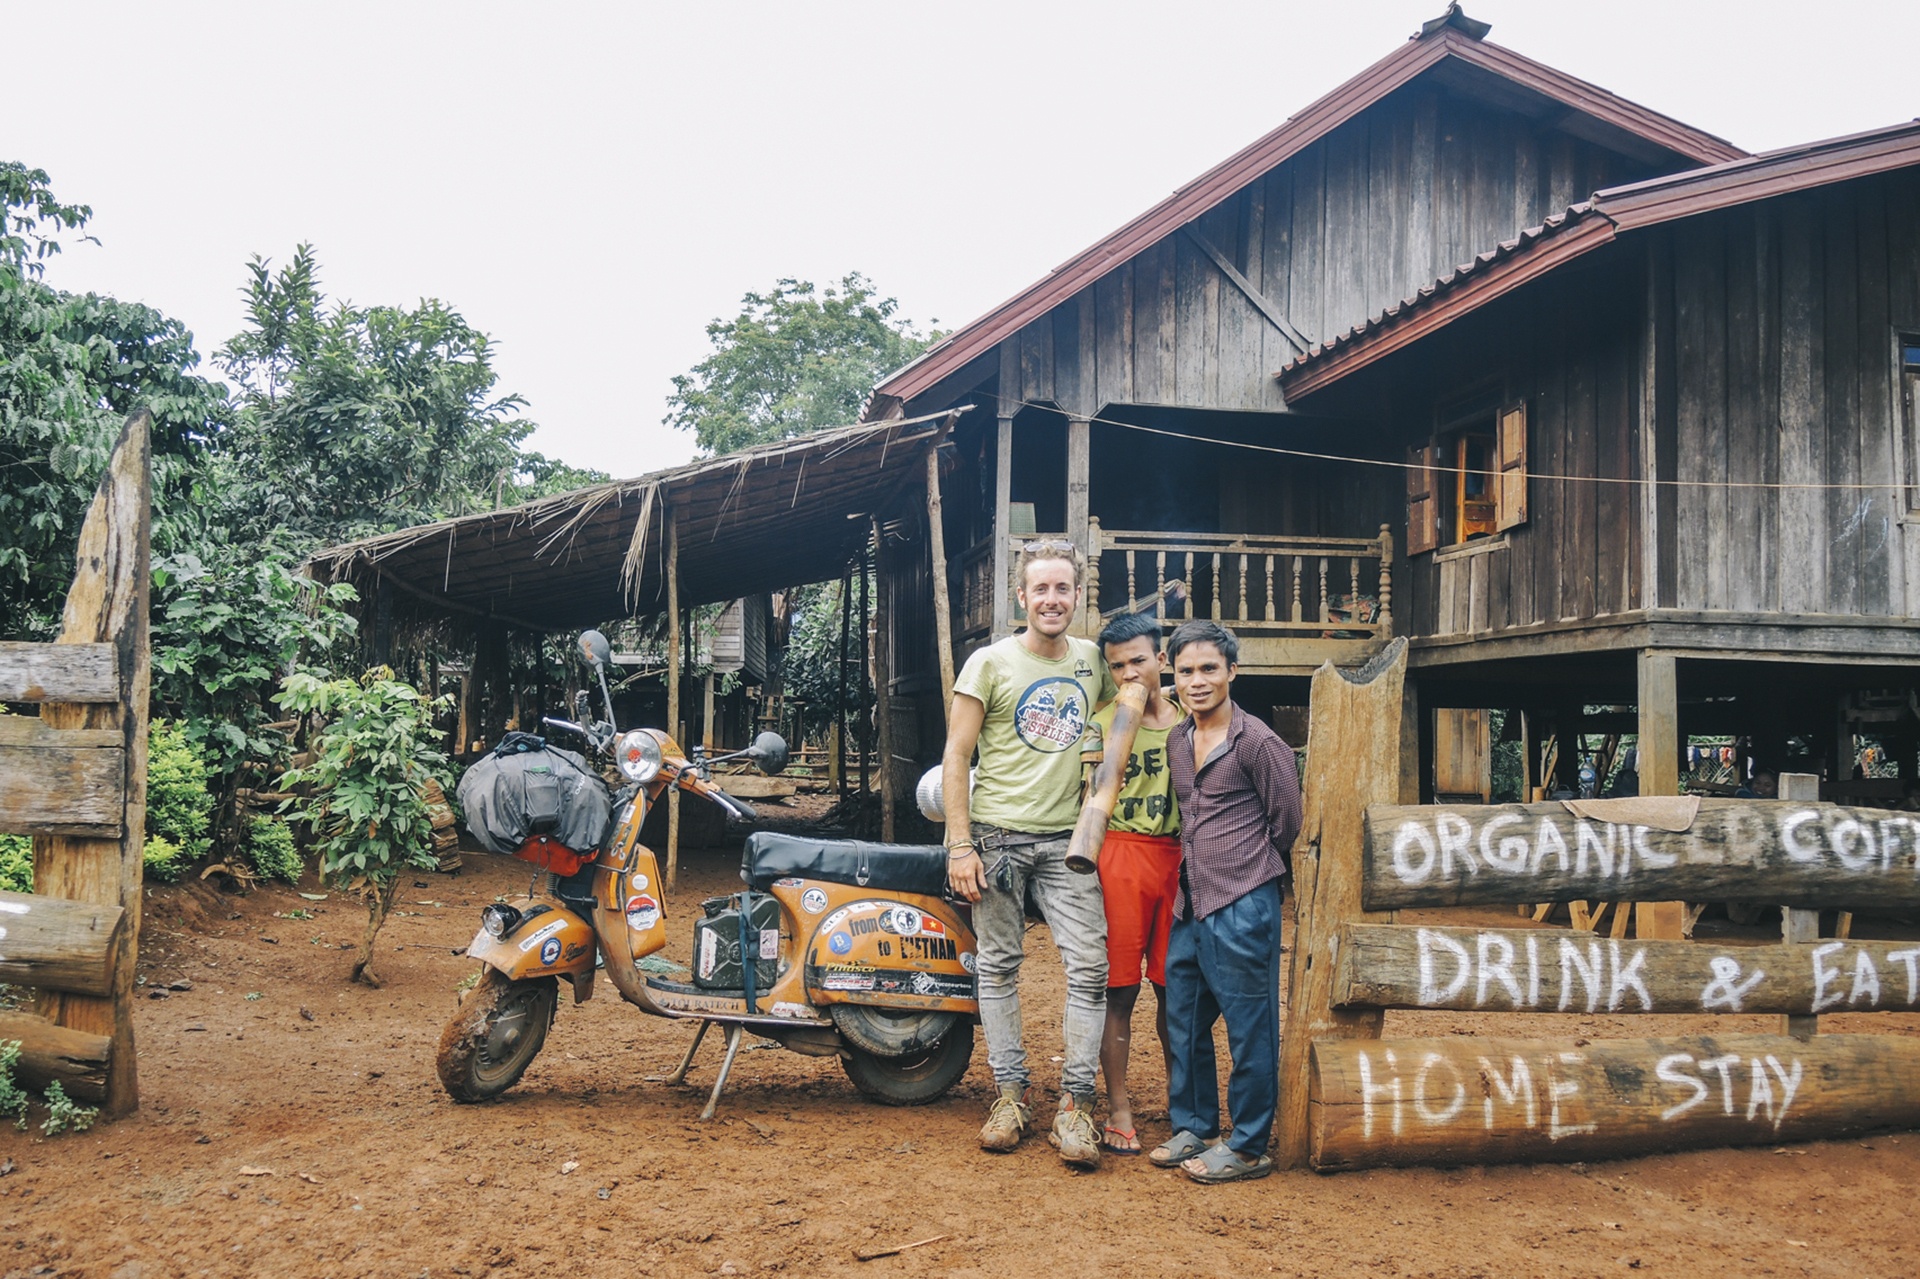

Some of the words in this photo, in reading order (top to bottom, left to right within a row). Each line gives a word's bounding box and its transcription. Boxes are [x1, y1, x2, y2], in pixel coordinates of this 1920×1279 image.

[1393, 811, 1678, 885] ORGANIC
[849, 917, 879, 938] from
[877, 939, 892, 957] to
[825, 961, 876, 973] Pinasco
[1416, 927, 1652, 1014] DRINK
[1700, 956, 1766, 1013] &
[1810, 941, 1920, 1013] EAT
[670, 998, 739, 1010] TOURATECH
[1358, 1048, 1600, 1143] HOME
[1654, 1052, 1802, 1133] STAY
